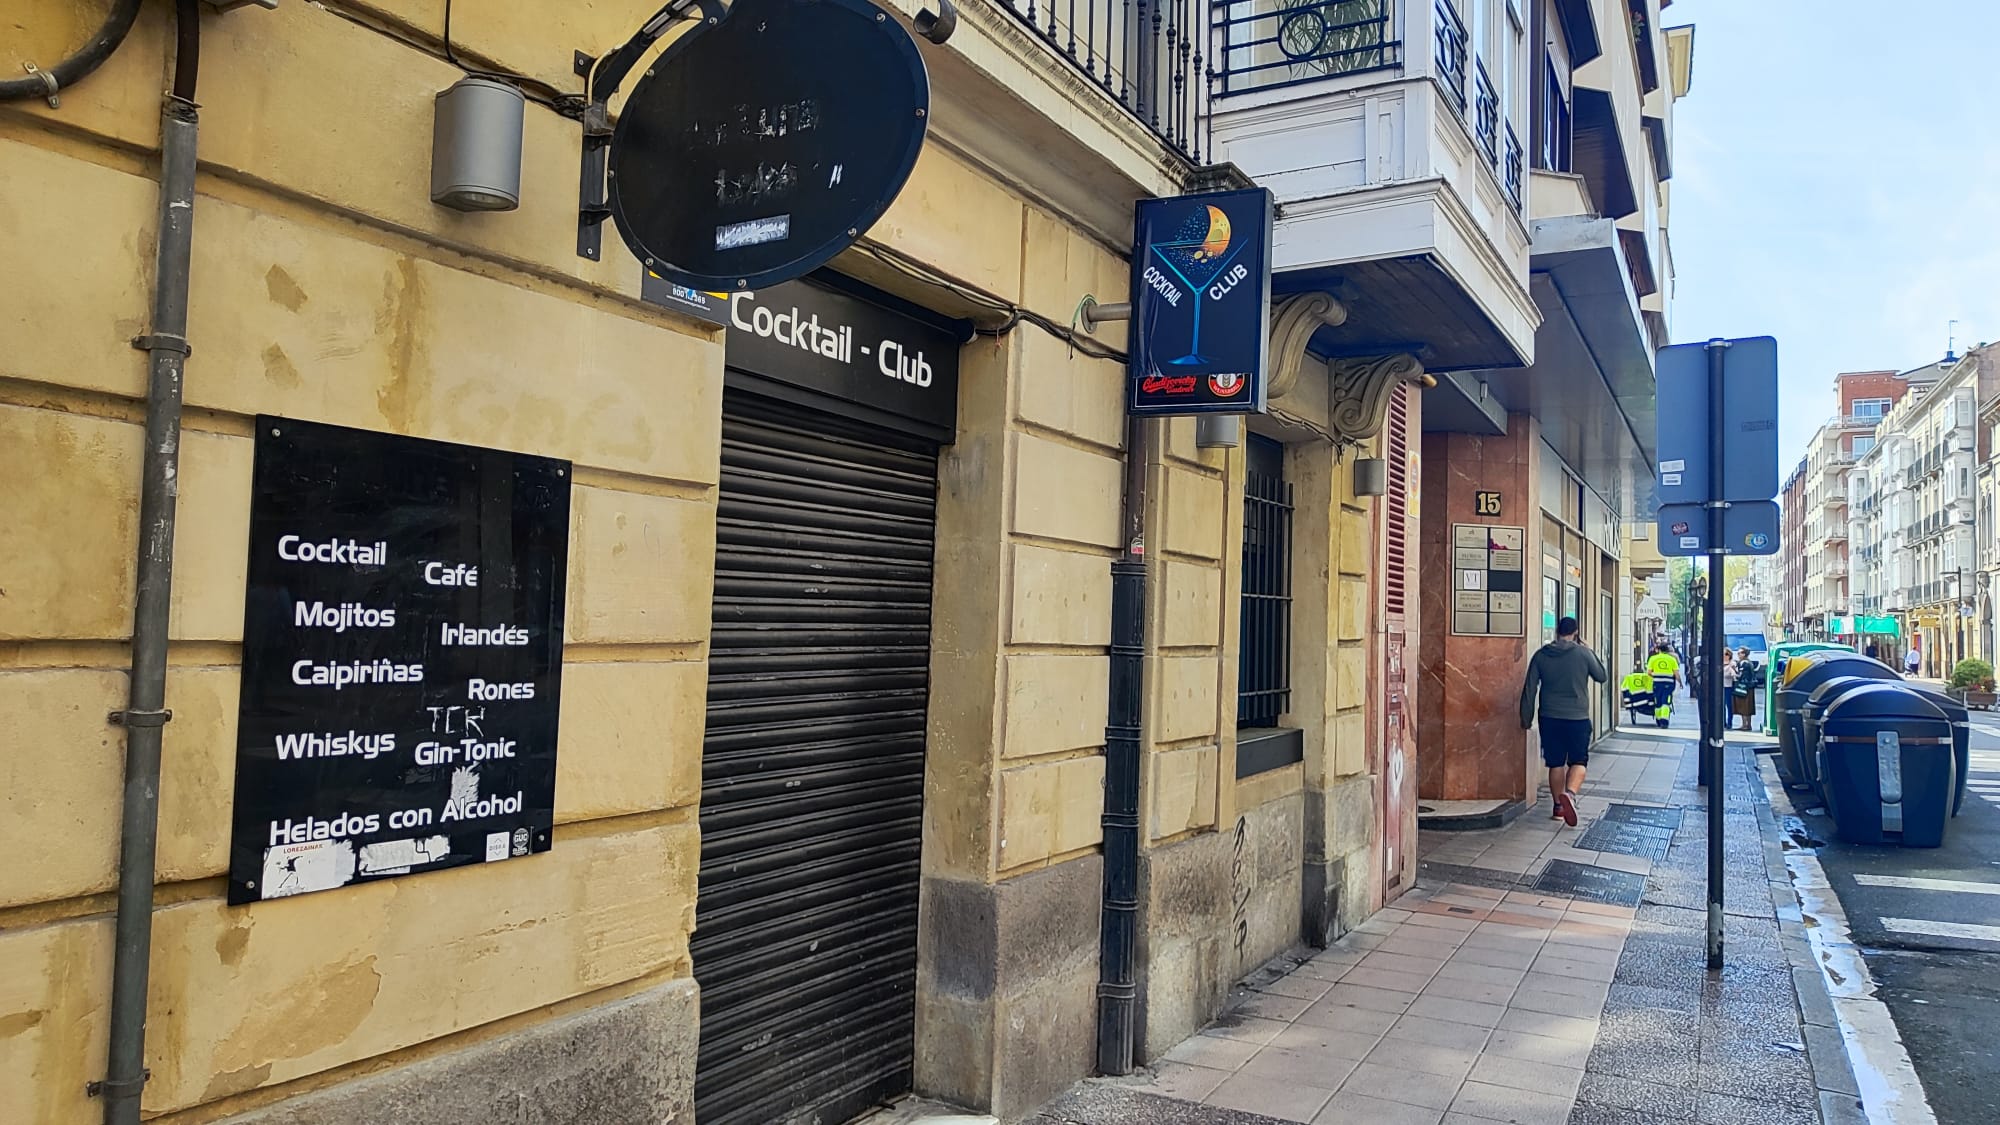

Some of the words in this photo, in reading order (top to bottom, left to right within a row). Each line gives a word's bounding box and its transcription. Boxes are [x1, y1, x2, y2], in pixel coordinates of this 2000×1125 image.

[1143, 265, 1183, 307] COCKTAIL
[1209, 263, 1248, 301] CLUB
[731, 291, 852, 364] Cocktail
[878, 340, 933, 388] Club
[1478, 492, 1501, 514] 15
[278, 534, 387, 565] Cocktail
[424, 562, 478, 587] Café
[295, 601, 396, 633] Mojitos
[441, 622, 529, 646] Irlandés
[292, 658, 424, 690] Caipiriñas
[468, 678, 535, 701] Rones
[275, 730, 396, 760] Whiskys
[414, 737, 517, 766] Gin-Tonic
[269, 812, 380, 846] Helados
[389, 807, 432, 829] con
[440, 790, 523, 824] Alcohol
